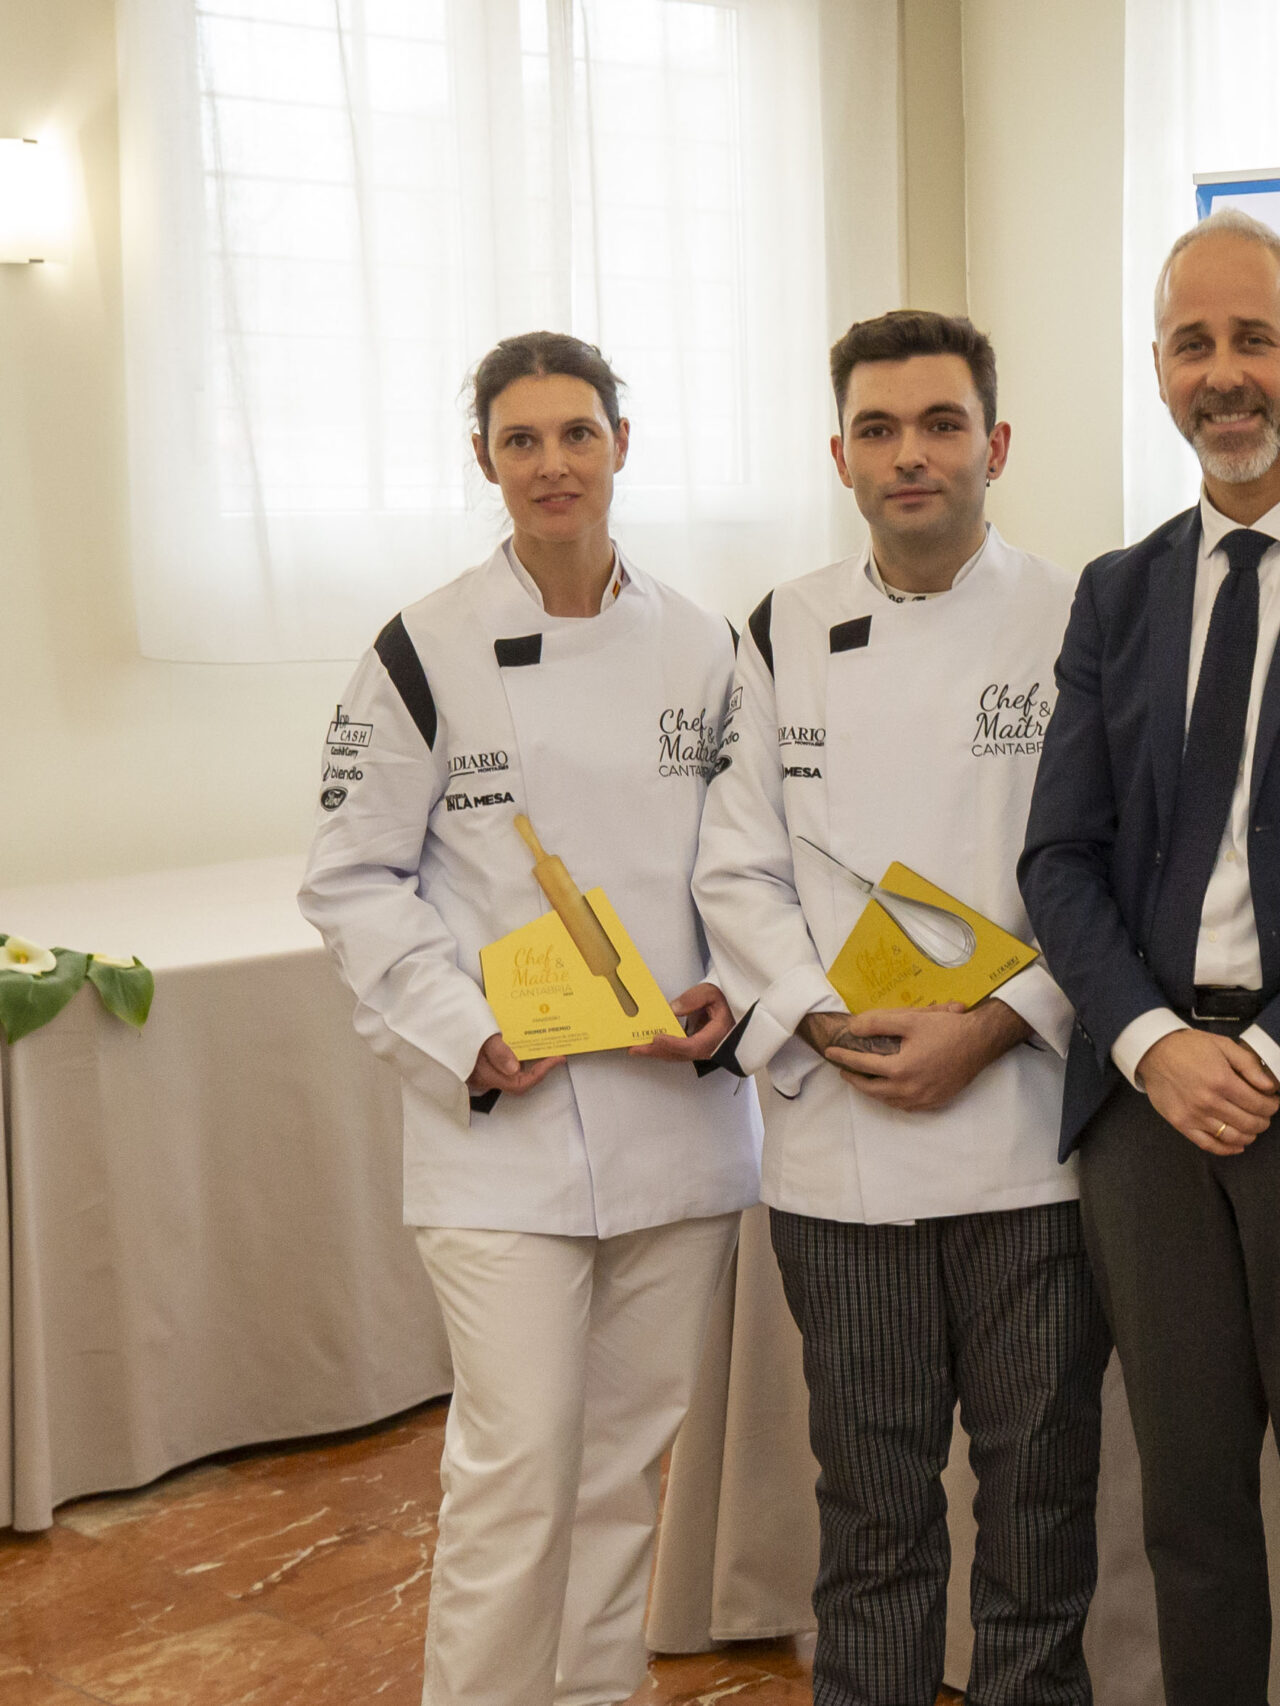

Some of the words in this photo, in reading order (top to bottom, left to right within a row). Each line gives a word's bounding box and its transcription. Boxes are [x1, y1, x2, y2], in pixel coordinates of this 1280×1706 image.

[980, 682, 1040, 718] Chef
[1038, 700, 1052, 718] &
[659, 707, 707, 740] Chef
[973, 711, 1047, 742] Maîtr
[340, 729, 367, 744] CASH
[971, 741, 1045, 758] CANTABR
[453, 749, 509, 772] DIARIO
[330, 765, 364, 781] blendo
[784, 766, 822, 779] MESA
[473, 791, 515, 808] MESA
[514, 943, 555, 970] Chef
